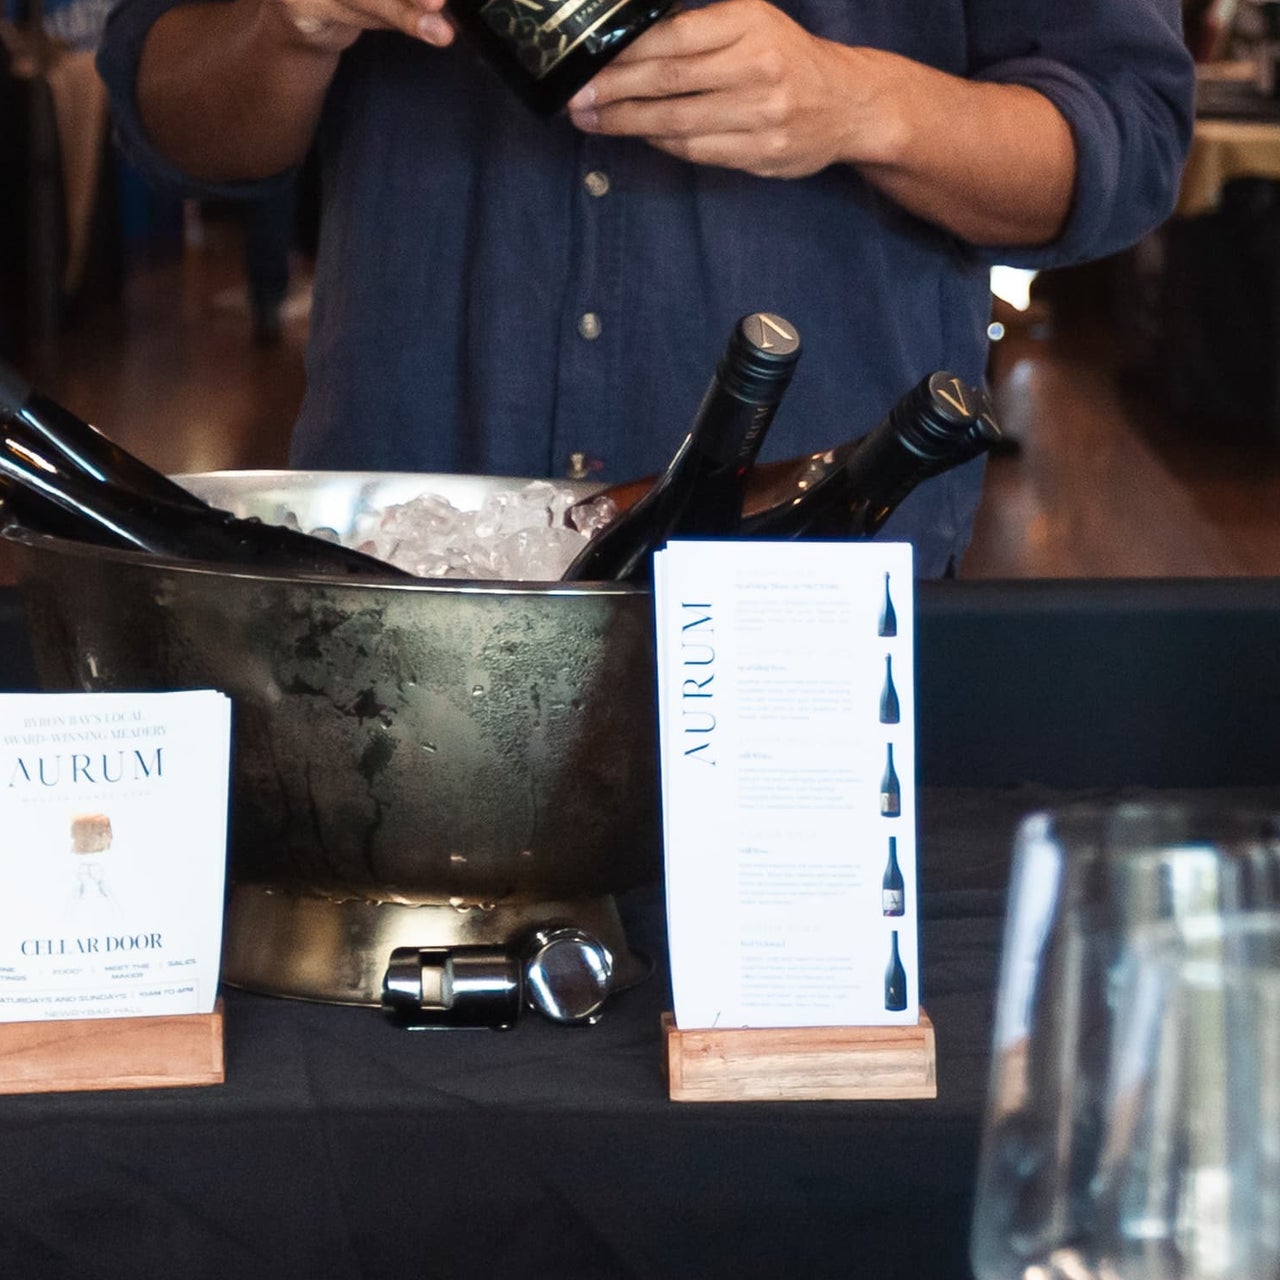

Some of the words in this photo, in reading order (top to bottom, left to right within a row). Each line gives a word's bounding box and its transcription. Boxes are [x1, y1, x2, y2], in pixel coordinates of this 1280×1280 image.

[681, 600, 717, 766] AURUM
[110, 724, 168, 740] MEADERY
[8, 747, 164, 788] AURUM
[21, 937, 100, 957] CELLAR
[106, 932, 164, 952] DOOR
[79, 993, 127, 1002] SUNDAYS
